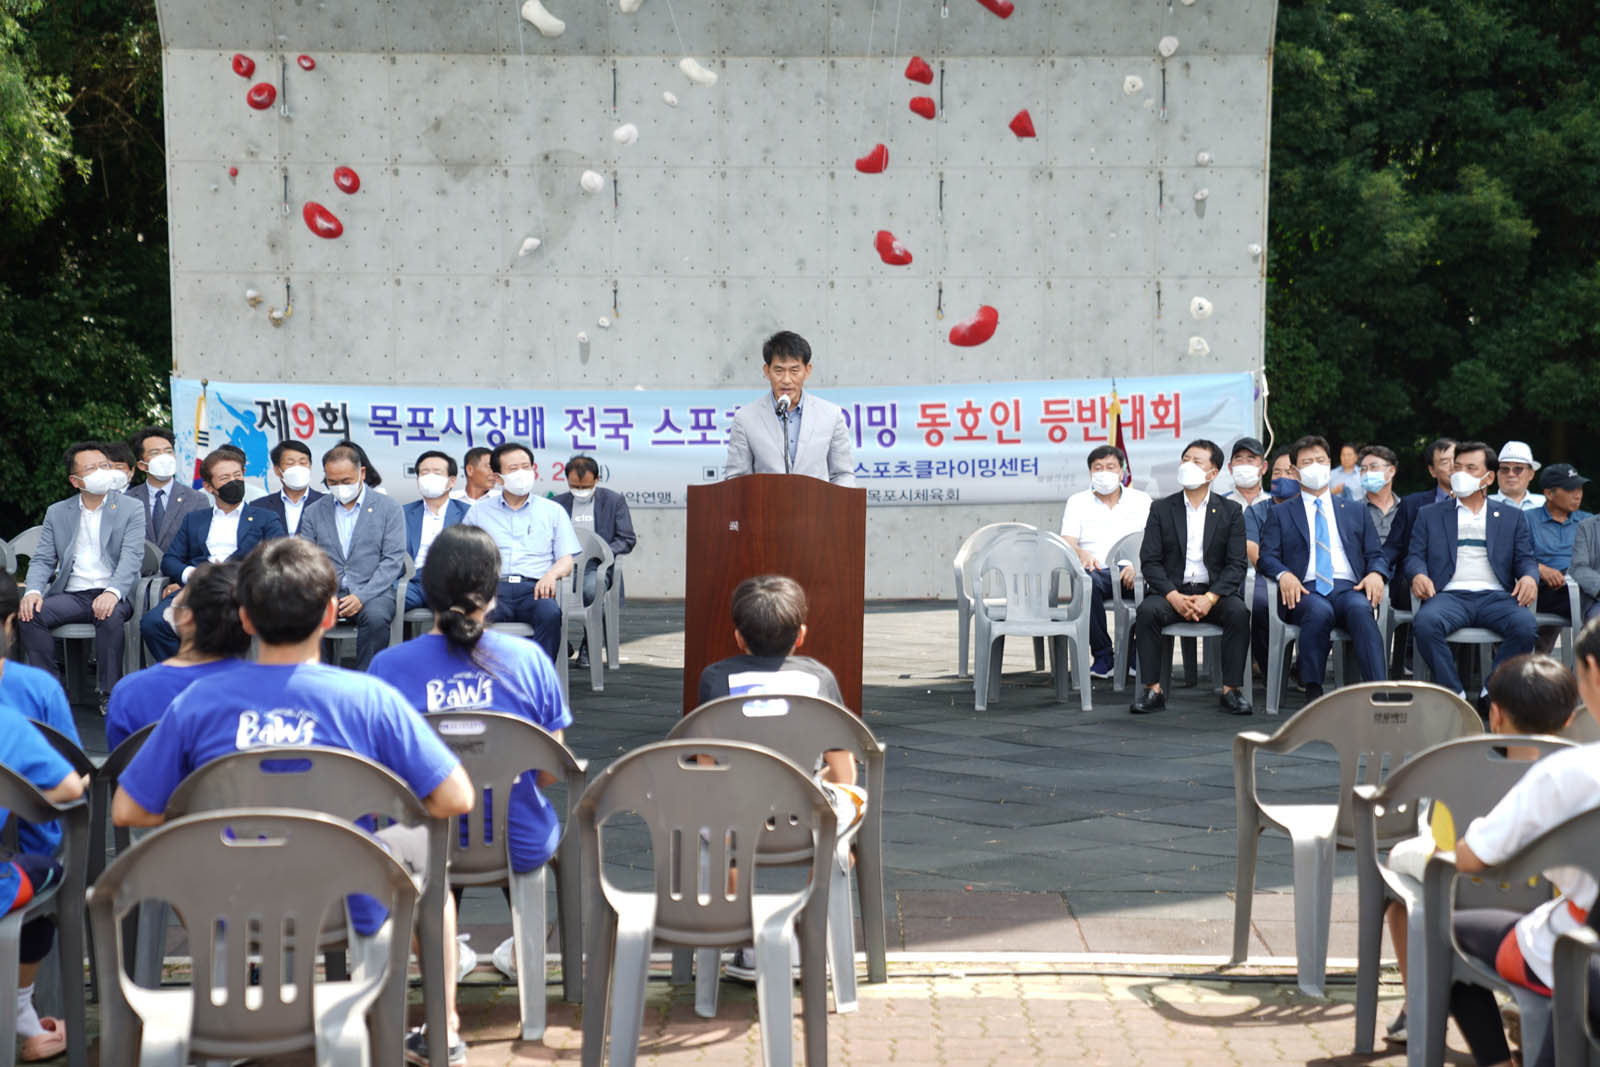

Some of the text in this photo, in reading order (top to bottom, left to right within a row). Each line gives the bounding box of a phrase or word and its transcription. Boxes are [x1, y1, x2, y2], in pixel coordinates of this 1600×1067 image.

[254, 399, 350, 442] 제9회
[368, 405, 546, 449] 목포시장배
[564, 407, 634, 450] 전국
[916, 399, 1022, 447] 동호인
[1040, 393, 1181, 444] 등반대회
[854, 457, 1038, 479] 스포츠클라이밍센터
[621, 491, 677, 504] 악연맹,
[867, 488, 959, 502] 목포시체육회
